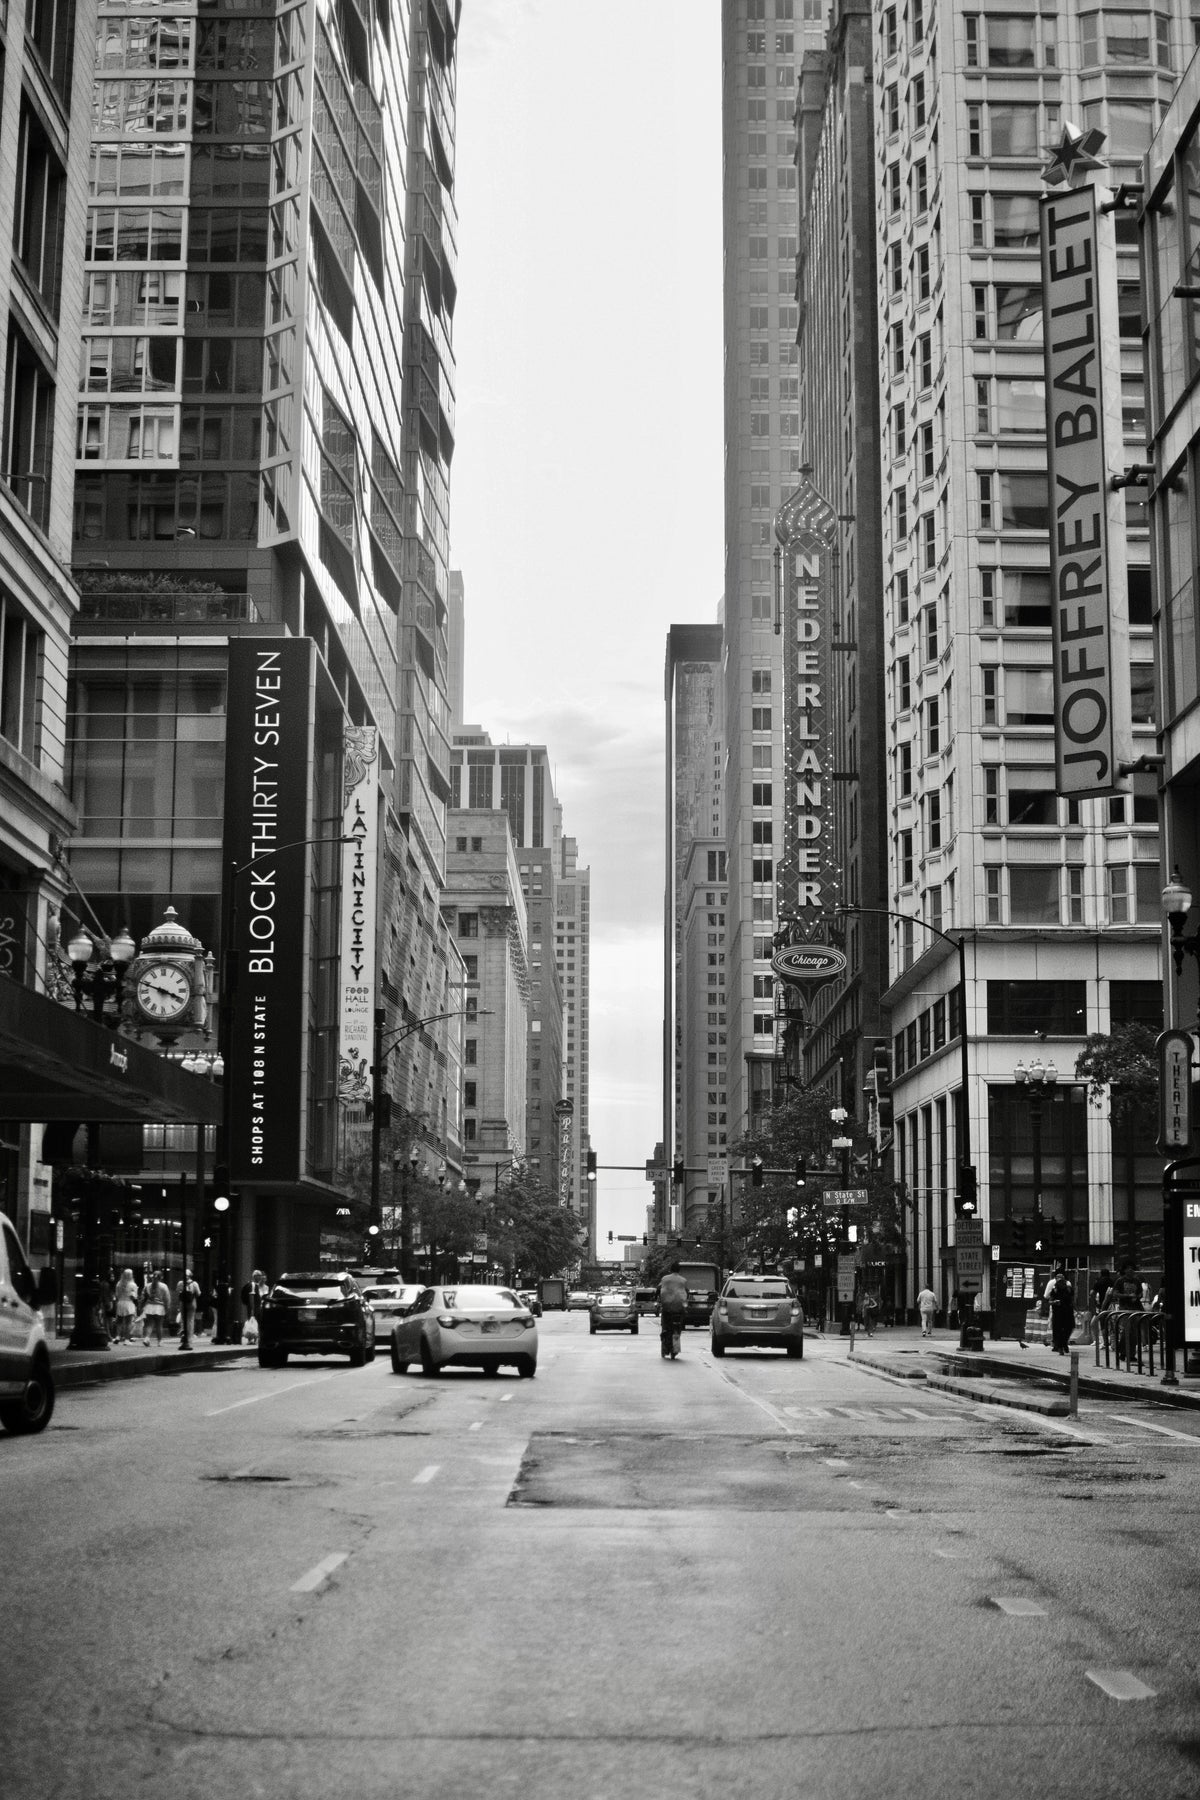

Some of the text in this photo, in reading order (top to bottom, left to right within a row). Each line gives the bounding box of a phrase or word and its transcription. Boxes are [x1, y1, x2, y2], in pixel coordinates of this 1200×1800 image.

[1048, 207, 1109, 781] JOFFREY BALLET
[794, 554, 823, 907] NEDERLANDER
[248, 652, 281, 973] BLOCK THIRTY SEVEN
[351, 798, 368, 981] LATINICITY
[791, 954, 829, 969] Chicago
[345, 986, 369, 995] FOOD
[345, 995, 369, 1003] HALL
[251, 995, 267, 1164] SHOPS AT 108 N STATE
[1172, 1051, 1181, 1142] THEATRE
[825, 1190, 865, 1200] N State St
[957, 1221, 982, 1230] DETOUR
[957, 1235, 982, 1244] SOUTH
[960, 1251, 979, 1261] STATE
[958, 1262, 982, 1270] STREET
